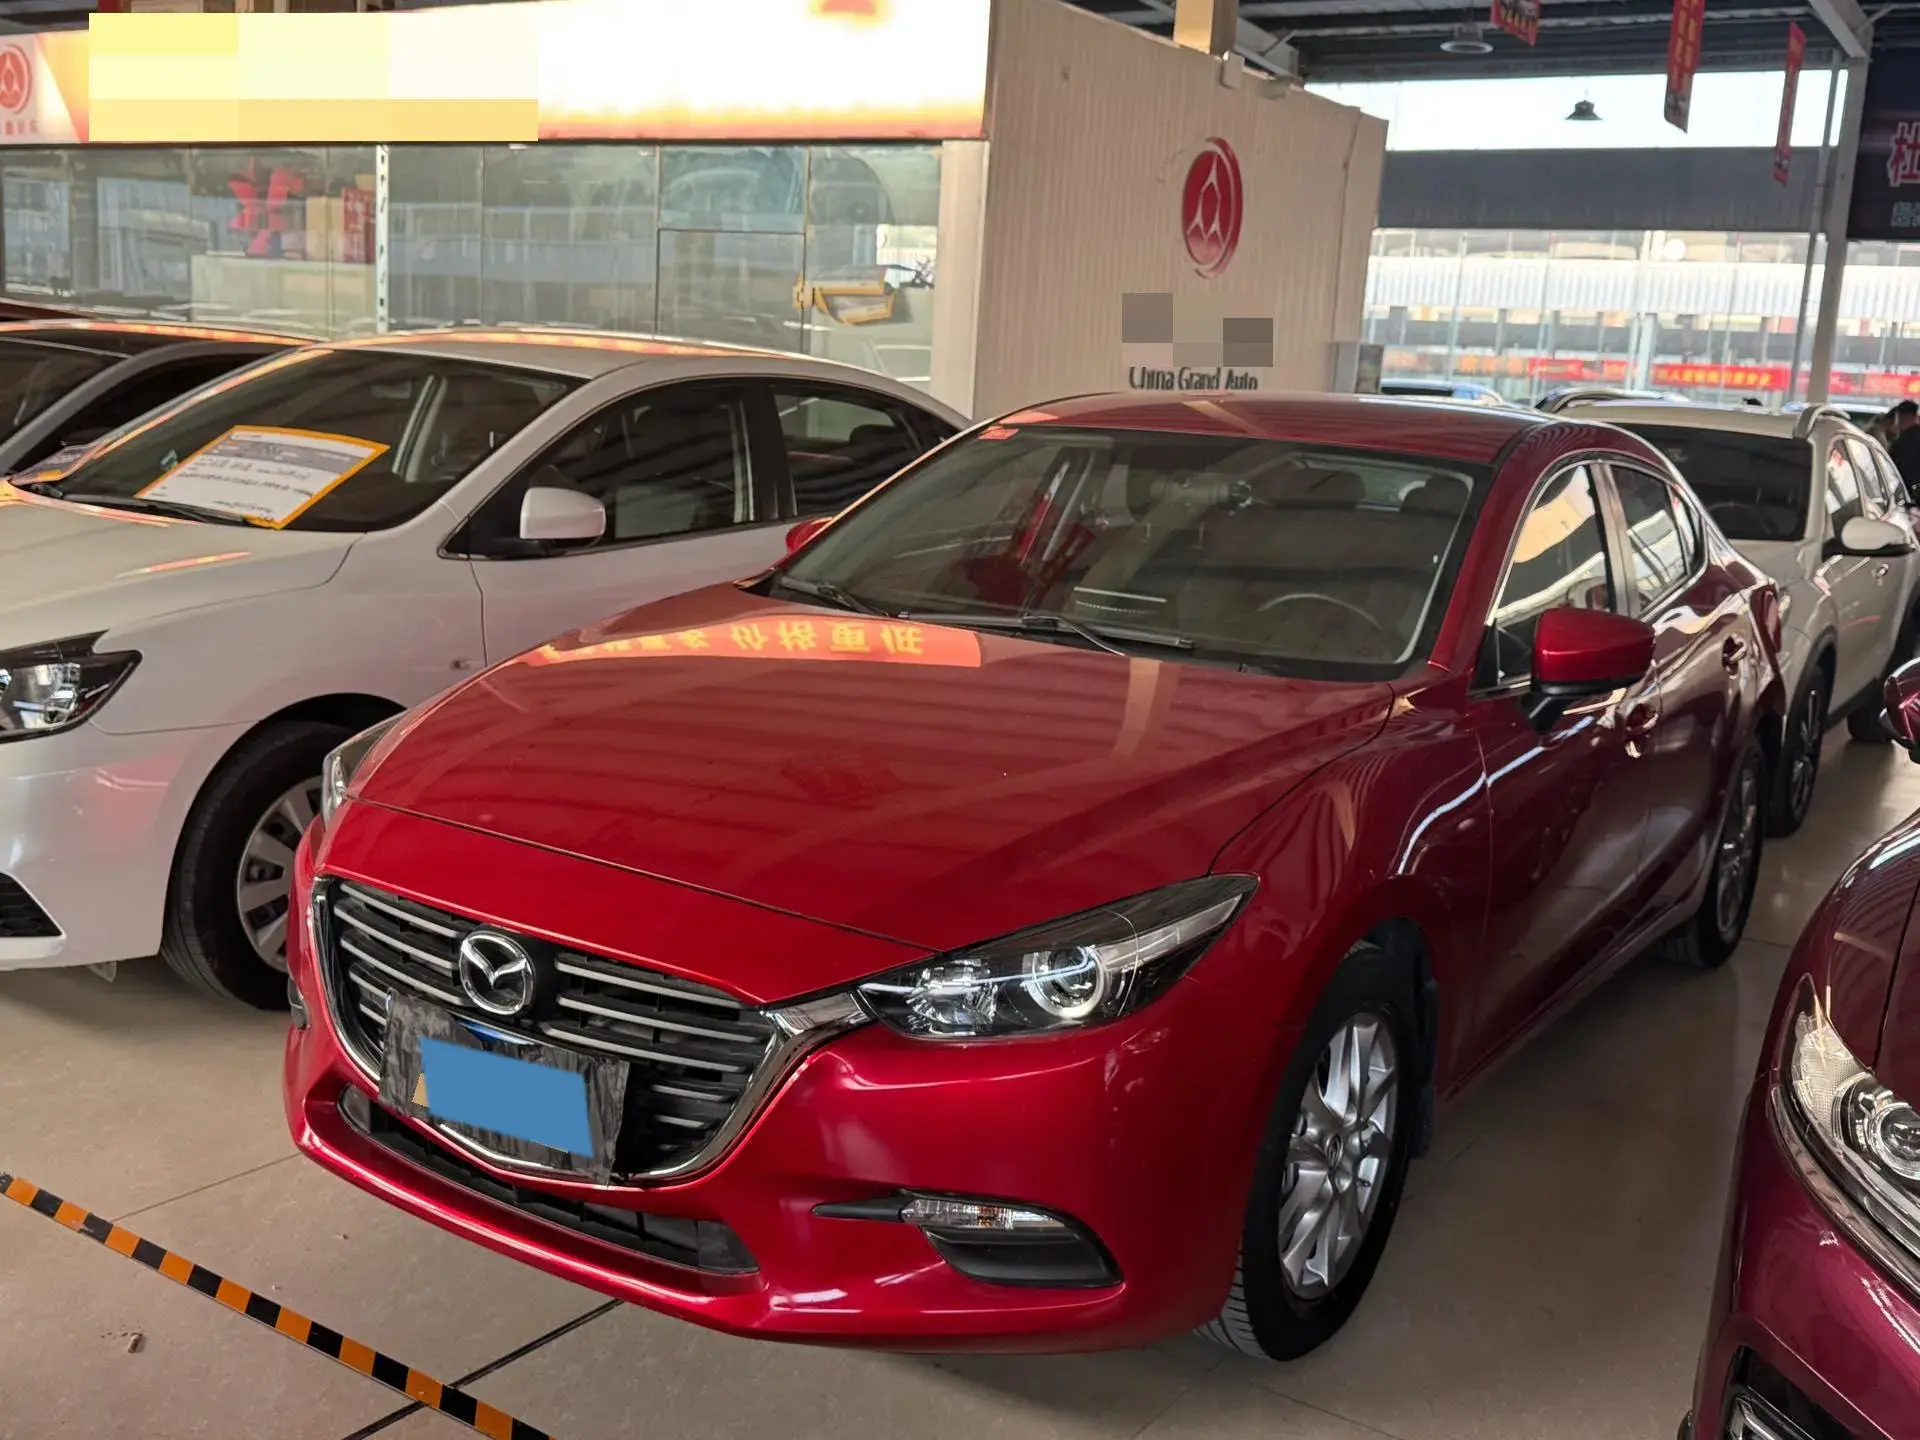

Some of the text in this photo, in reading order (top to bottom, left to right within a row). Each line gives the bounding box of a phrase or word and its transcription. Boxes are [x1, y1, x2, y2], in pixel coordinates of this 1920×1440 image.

[1129, 366, 1258, 390] China Grand Auto
